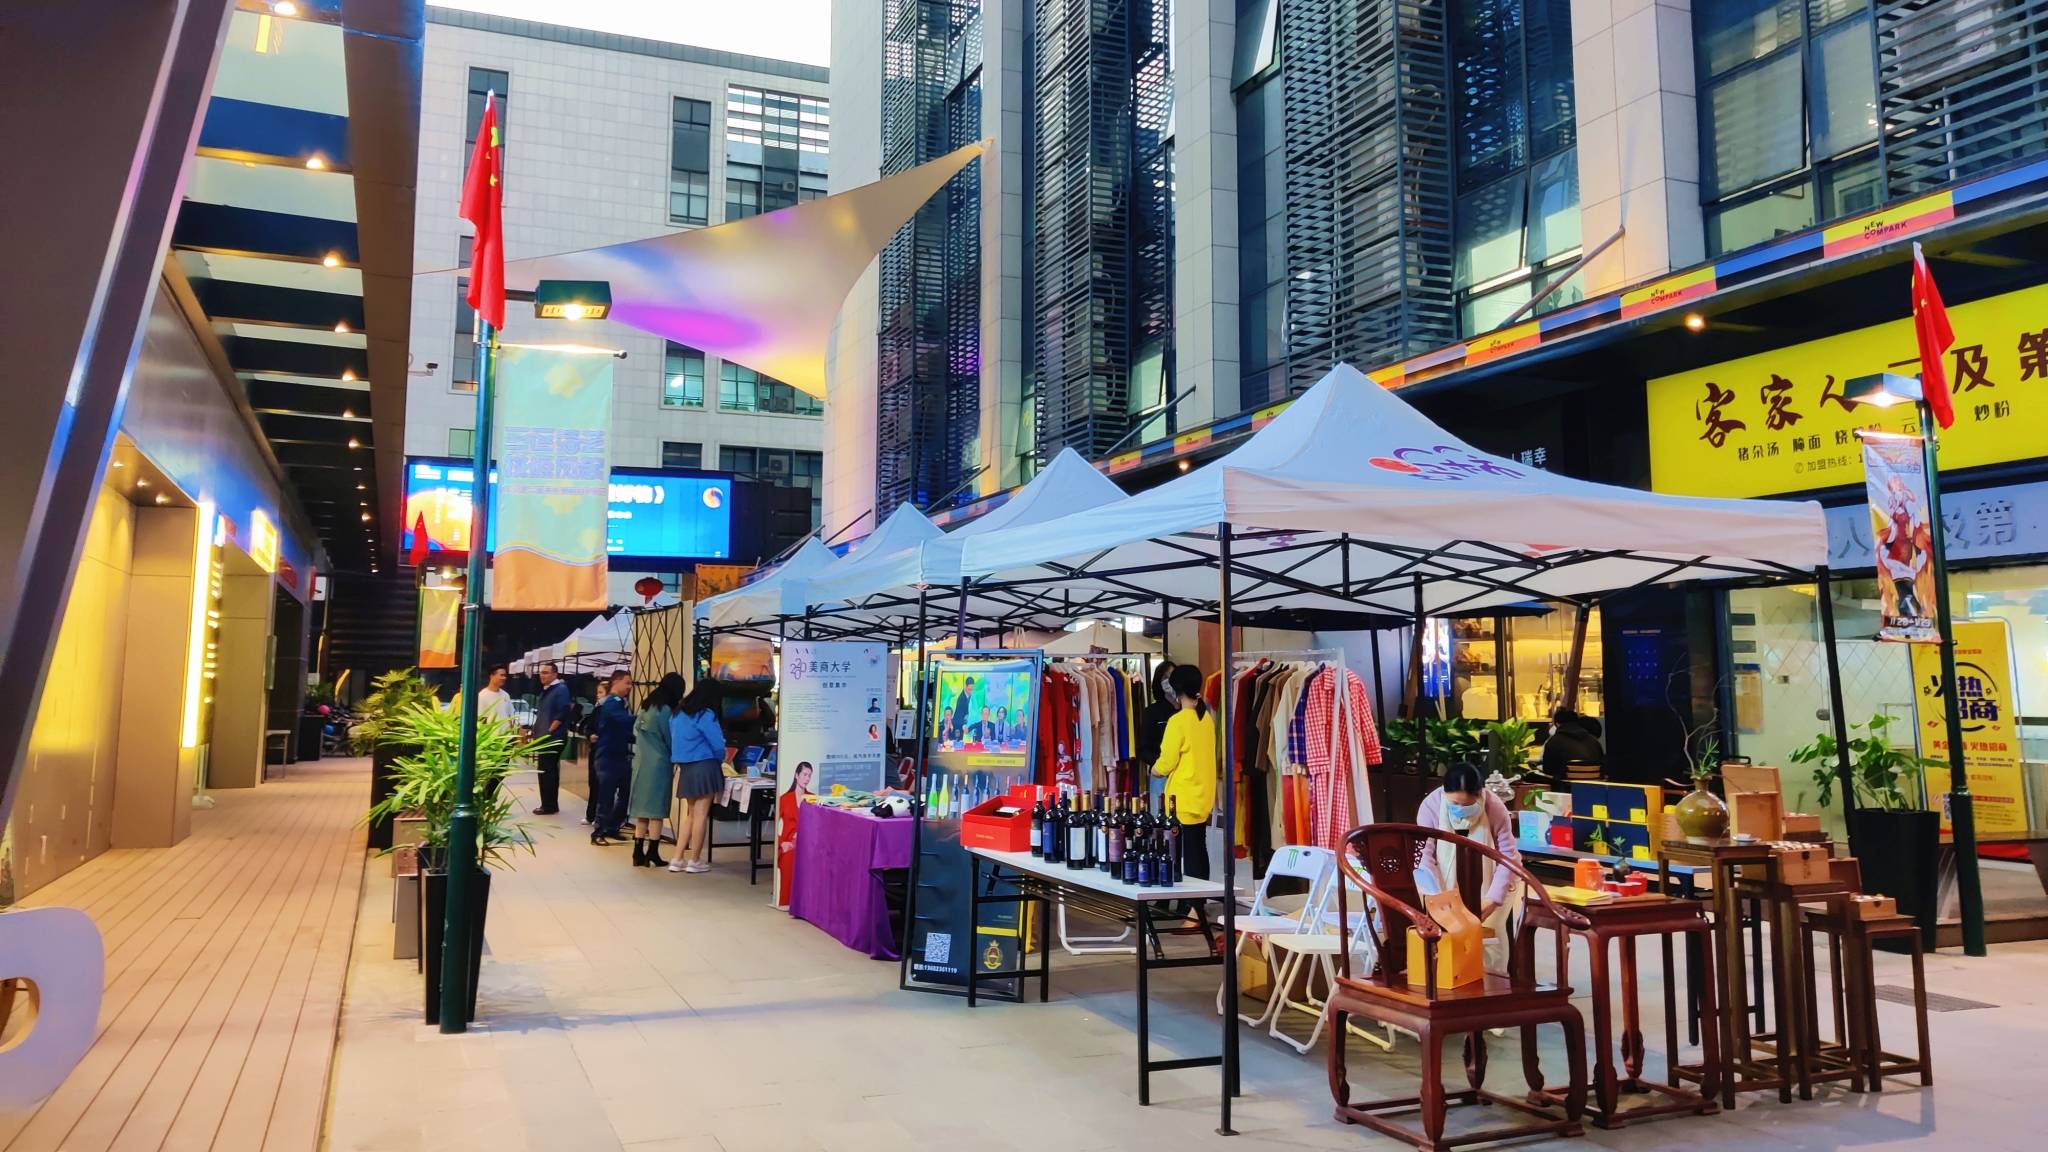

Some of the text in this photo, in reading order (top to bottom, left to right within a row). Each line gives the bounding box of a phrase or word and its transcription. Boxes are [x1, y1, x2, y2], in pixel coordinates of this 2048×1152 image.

[1864, 220, 1884, 231] NEW
[1864, 221, 1908, 239] COMPARK
[1974, 400, 2010, 421] 炒粉
[808, 660, 852, 673] 美商大学
